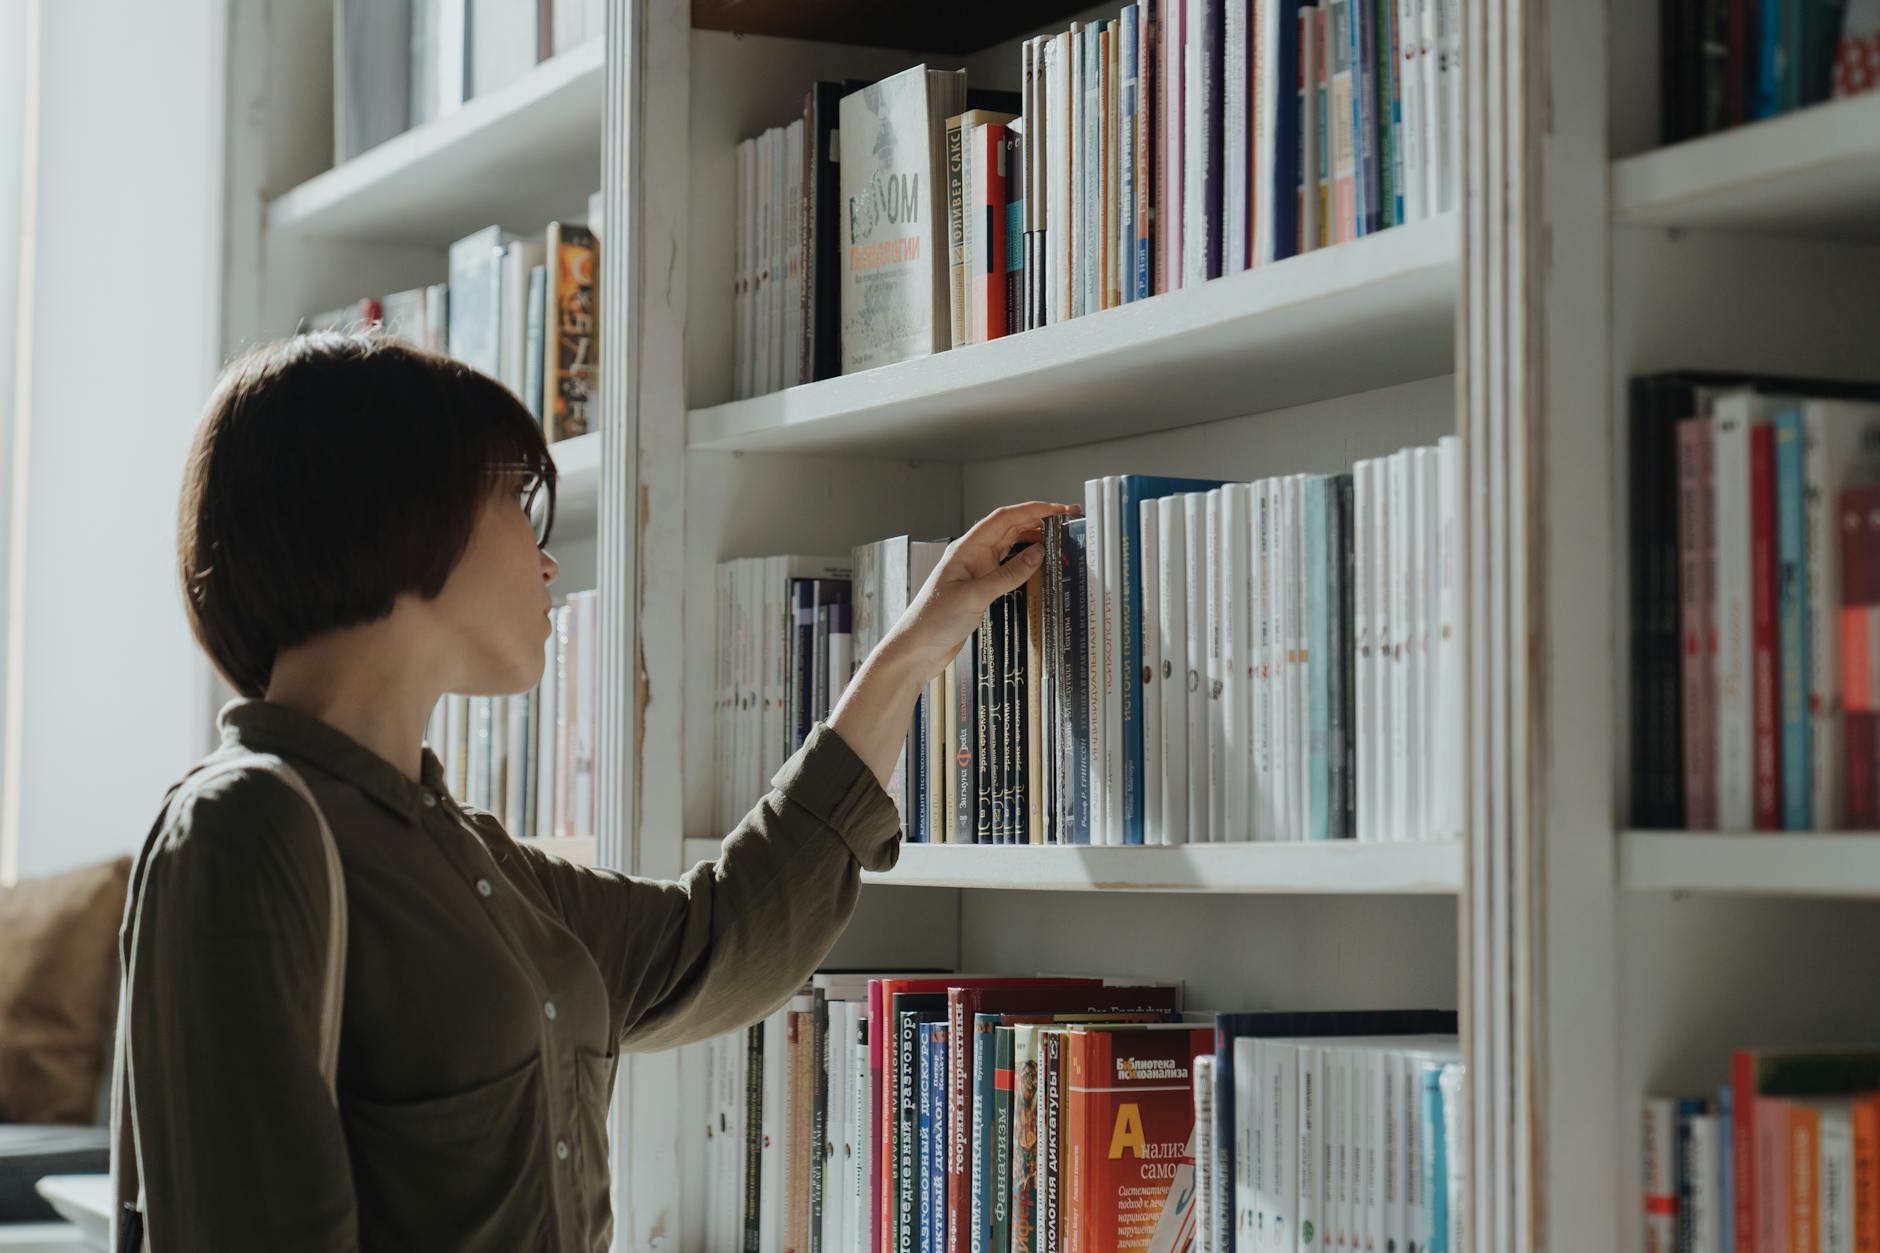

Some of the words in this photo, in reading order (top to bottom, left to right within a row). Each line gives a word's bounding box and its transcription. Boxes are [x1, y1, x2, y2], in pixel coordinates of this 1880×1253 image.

[950, 133, 961, 172] САКС
[951, 178, 962, 240] ОЛИВЕР
[1063, 591, 1071, 612] тела
[1088, 526, 1097, 623] ПСИХОЛОГИЯ
[1121, 536, 1131, 656] ПСИХОТЕРАПИИ
[1063, 616, 1072, 652] Театры
[1104, 591, 1113, 695] ПСИХОЛОГИЯ
[1090, 625, 1098, 761] ИНДИВИДУАЛЬНАЯ
[1122, 660, 1132, 721] ИСТОКИ
[956, 728, 972, 767] Фрейд
[979, 704, 987, 747] ФРОММ
[959, 768, 970, 809] Зигмунд
[980, 747, 988, 773] Эрих
[1080, 737, 1088, 787] ГРИНСОН
[901, 1016, 916, 1110] разговор
[920, 1033, 931, 1117] ДИСКУРС
[955, 1003, 967, 1090] практики
[1116, 1057, 1176, 1070] Библиотека
[1118, 1067, 1189, 1081] психоанализа
[955, 1094, 964, 1106] и
[1048, 1070, 1060, 1172] диктатуры
[934, 1095, 944, 1172] ДИАЛОГ
[954, 1110, 967, 1174] теории
[972, 1094, 984, 1253] ОММУНИКАЦИИ
[994, 1108, 1008, 1222] Фанатизм
[1118, 1185, 1170, 1197] Систематиче
[1140, 1163, 1177, 1179] само
[933, 1175, 943, 1253] ИКТНЫЙ
[950, 1209, 958, 1253] иффин
[1047, 1177, 1058, 1253] хология
[1118, 1196, 1143, 1209] подход
